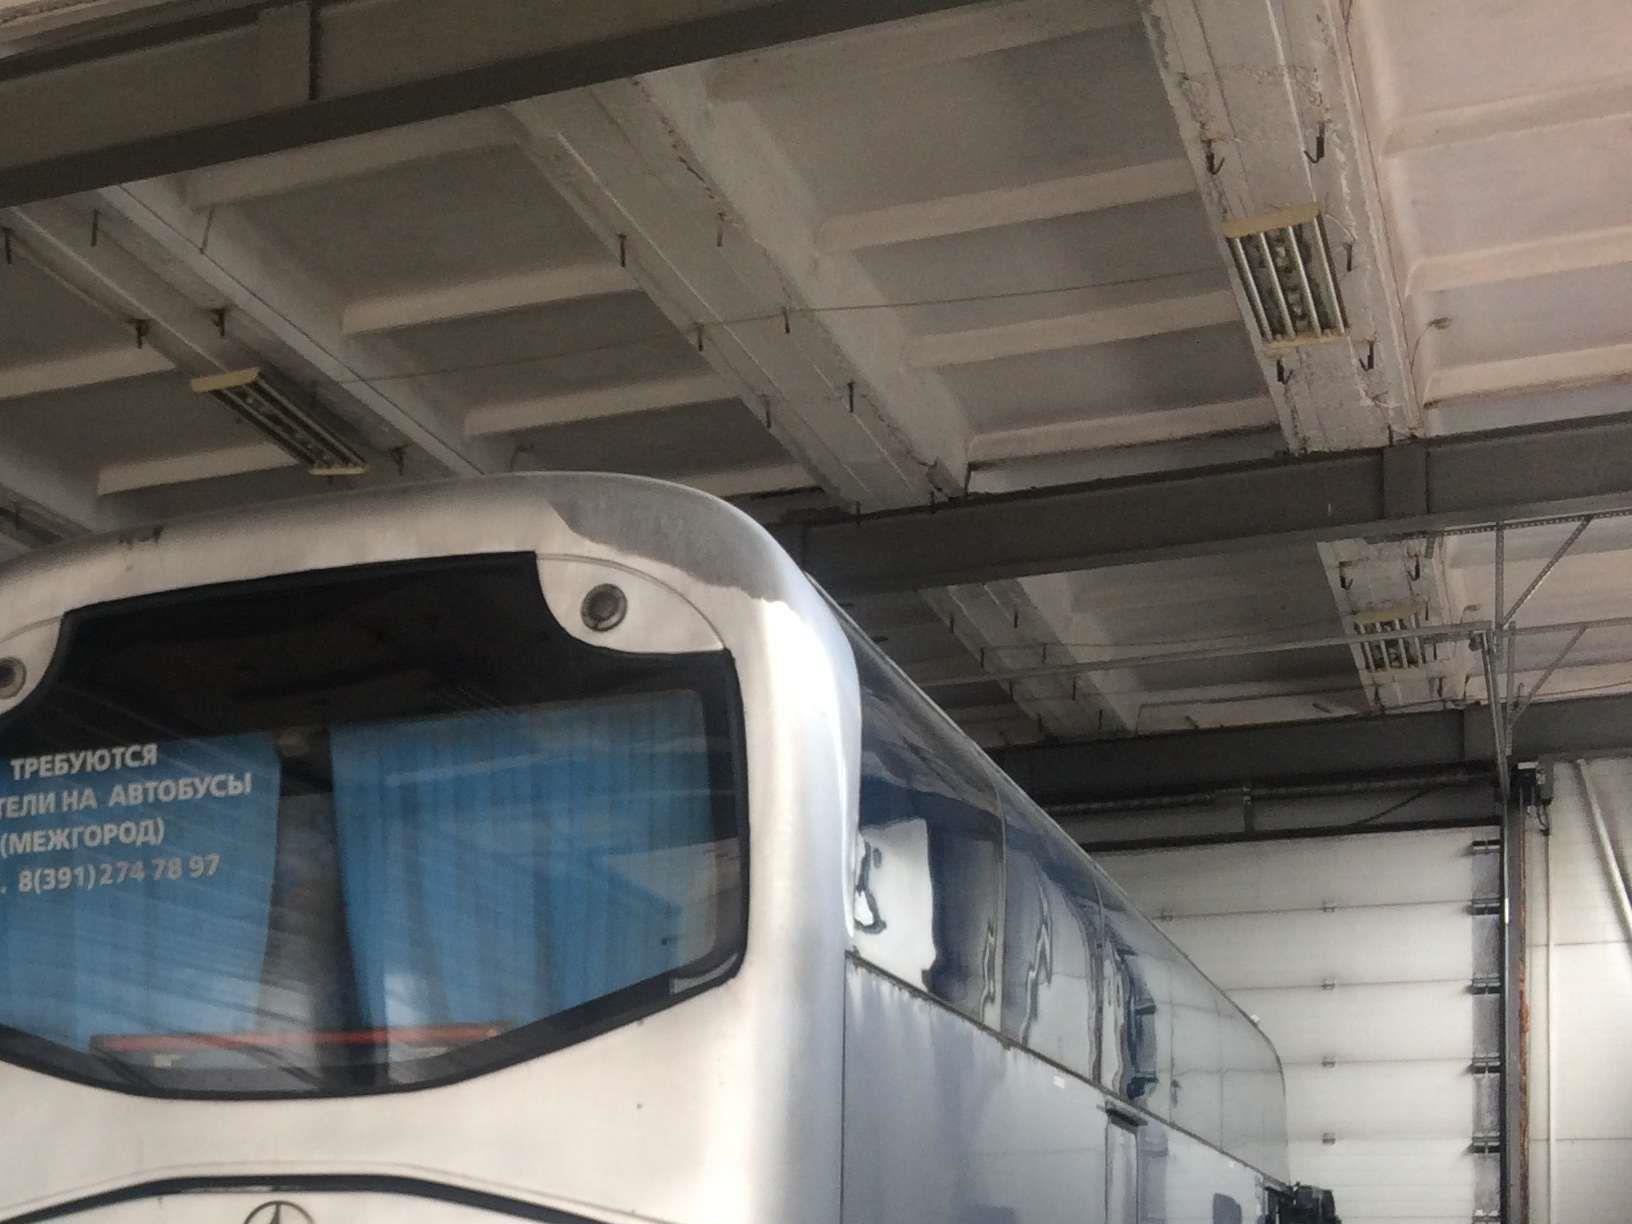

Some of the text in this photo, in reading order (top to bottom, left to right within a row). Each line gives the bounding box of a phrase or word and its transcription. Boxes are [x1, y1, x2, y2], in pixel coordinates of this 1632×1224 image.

[10, 743, 158, 781] ТРЕБУЮТСЯ
[62, 787, 98, 811] НА
[109, 772, 252, 807] АВТОБУСЫ
[0, 817, 166, 858] (МЕЖГОРОД)
[188, 853, 221, 879] 97
